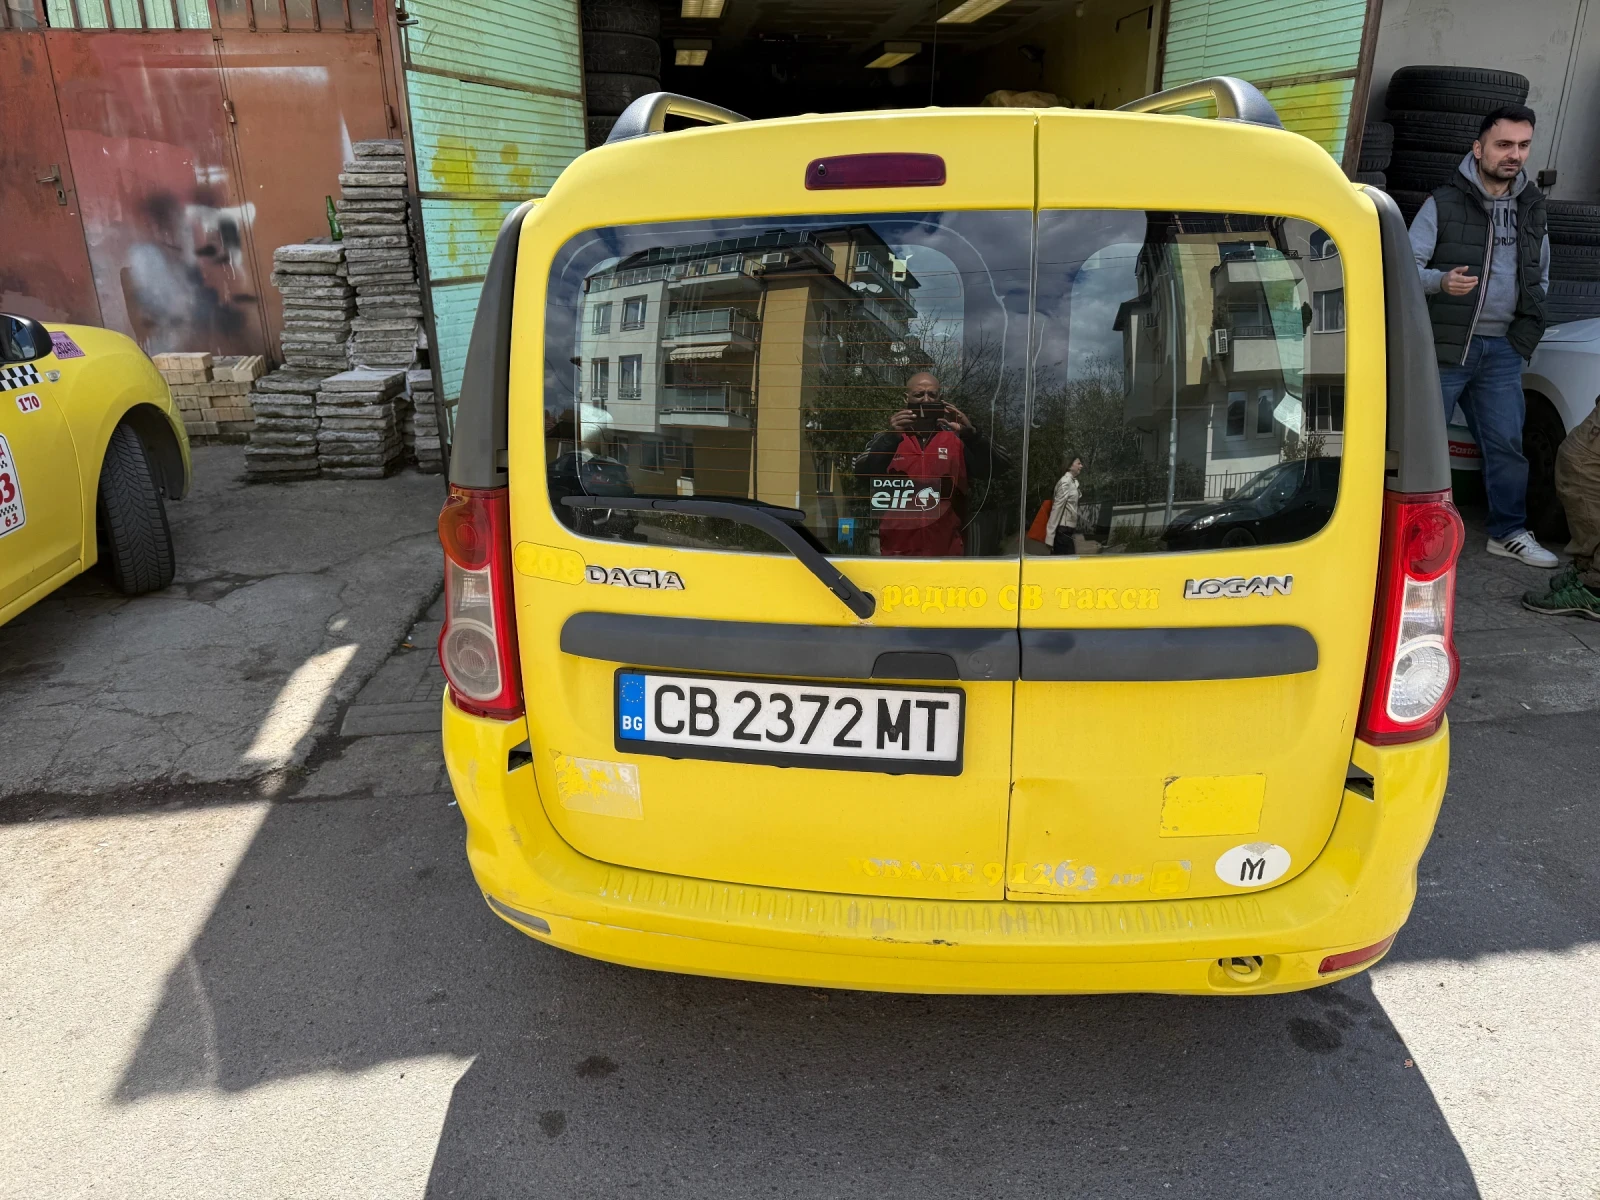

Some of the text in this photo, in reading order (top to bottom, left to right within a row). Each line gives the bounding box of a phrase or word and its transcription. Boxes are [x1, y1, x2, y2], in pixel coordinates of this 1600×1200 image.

[18, 395, 40, 412] 170
[873, 479, 915, 488] DACIA
[871, 489, 915, 509] elf
[586, 564, 686, 591] DACIA
[1183, 575, 1294, 600] LOGAN
[881, 584, 988, 614] радио
[1055, 587, 1161, 610] такси
[622, 715, 643, 731] BG
[654, 684, 949, 752] CB 2372 MT
